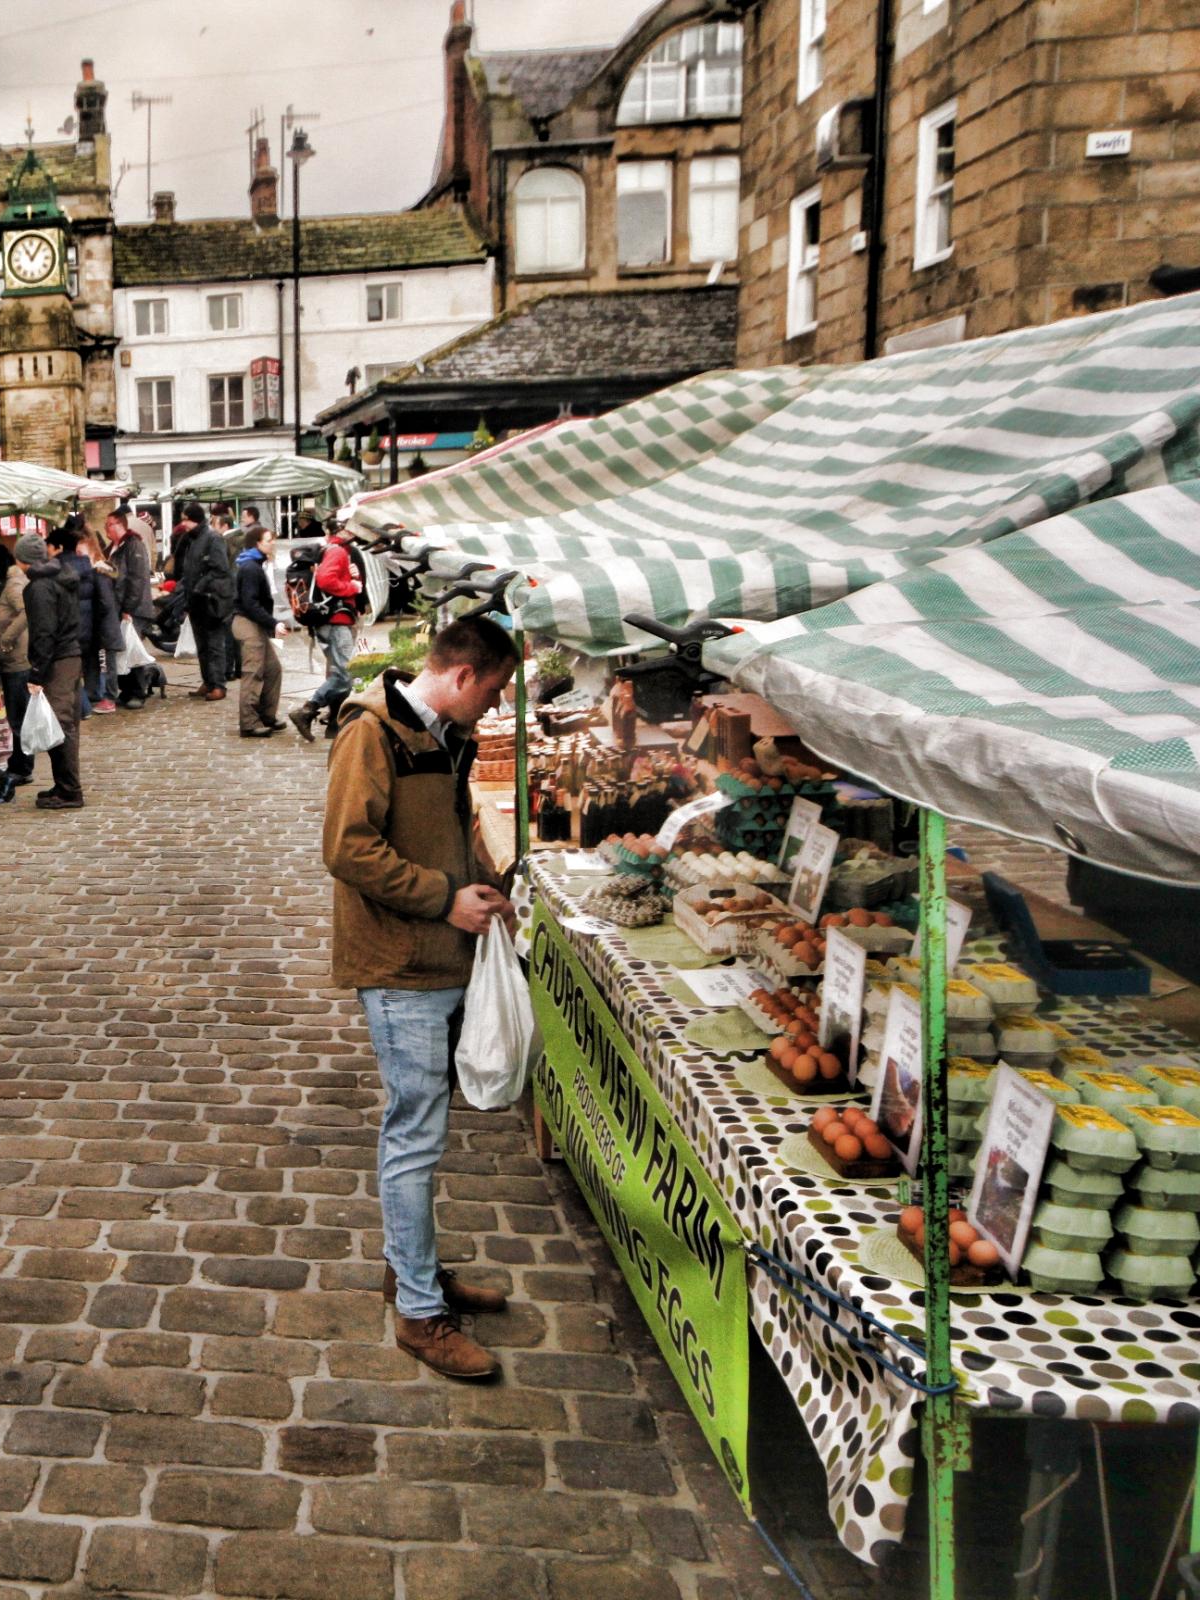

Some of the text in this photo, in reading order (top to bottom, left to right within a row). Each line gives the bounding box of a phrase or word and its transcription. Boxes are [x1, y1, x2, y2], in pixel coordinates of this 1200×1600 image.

[532, 921, 726, 1300] CHURCH VIEW FARM
[566, 1103, 653, 1291] WINNING
[656, 1257, 715, 1419] EGGS
[572, 1067, 626, 1187] PRODUCERS OF
